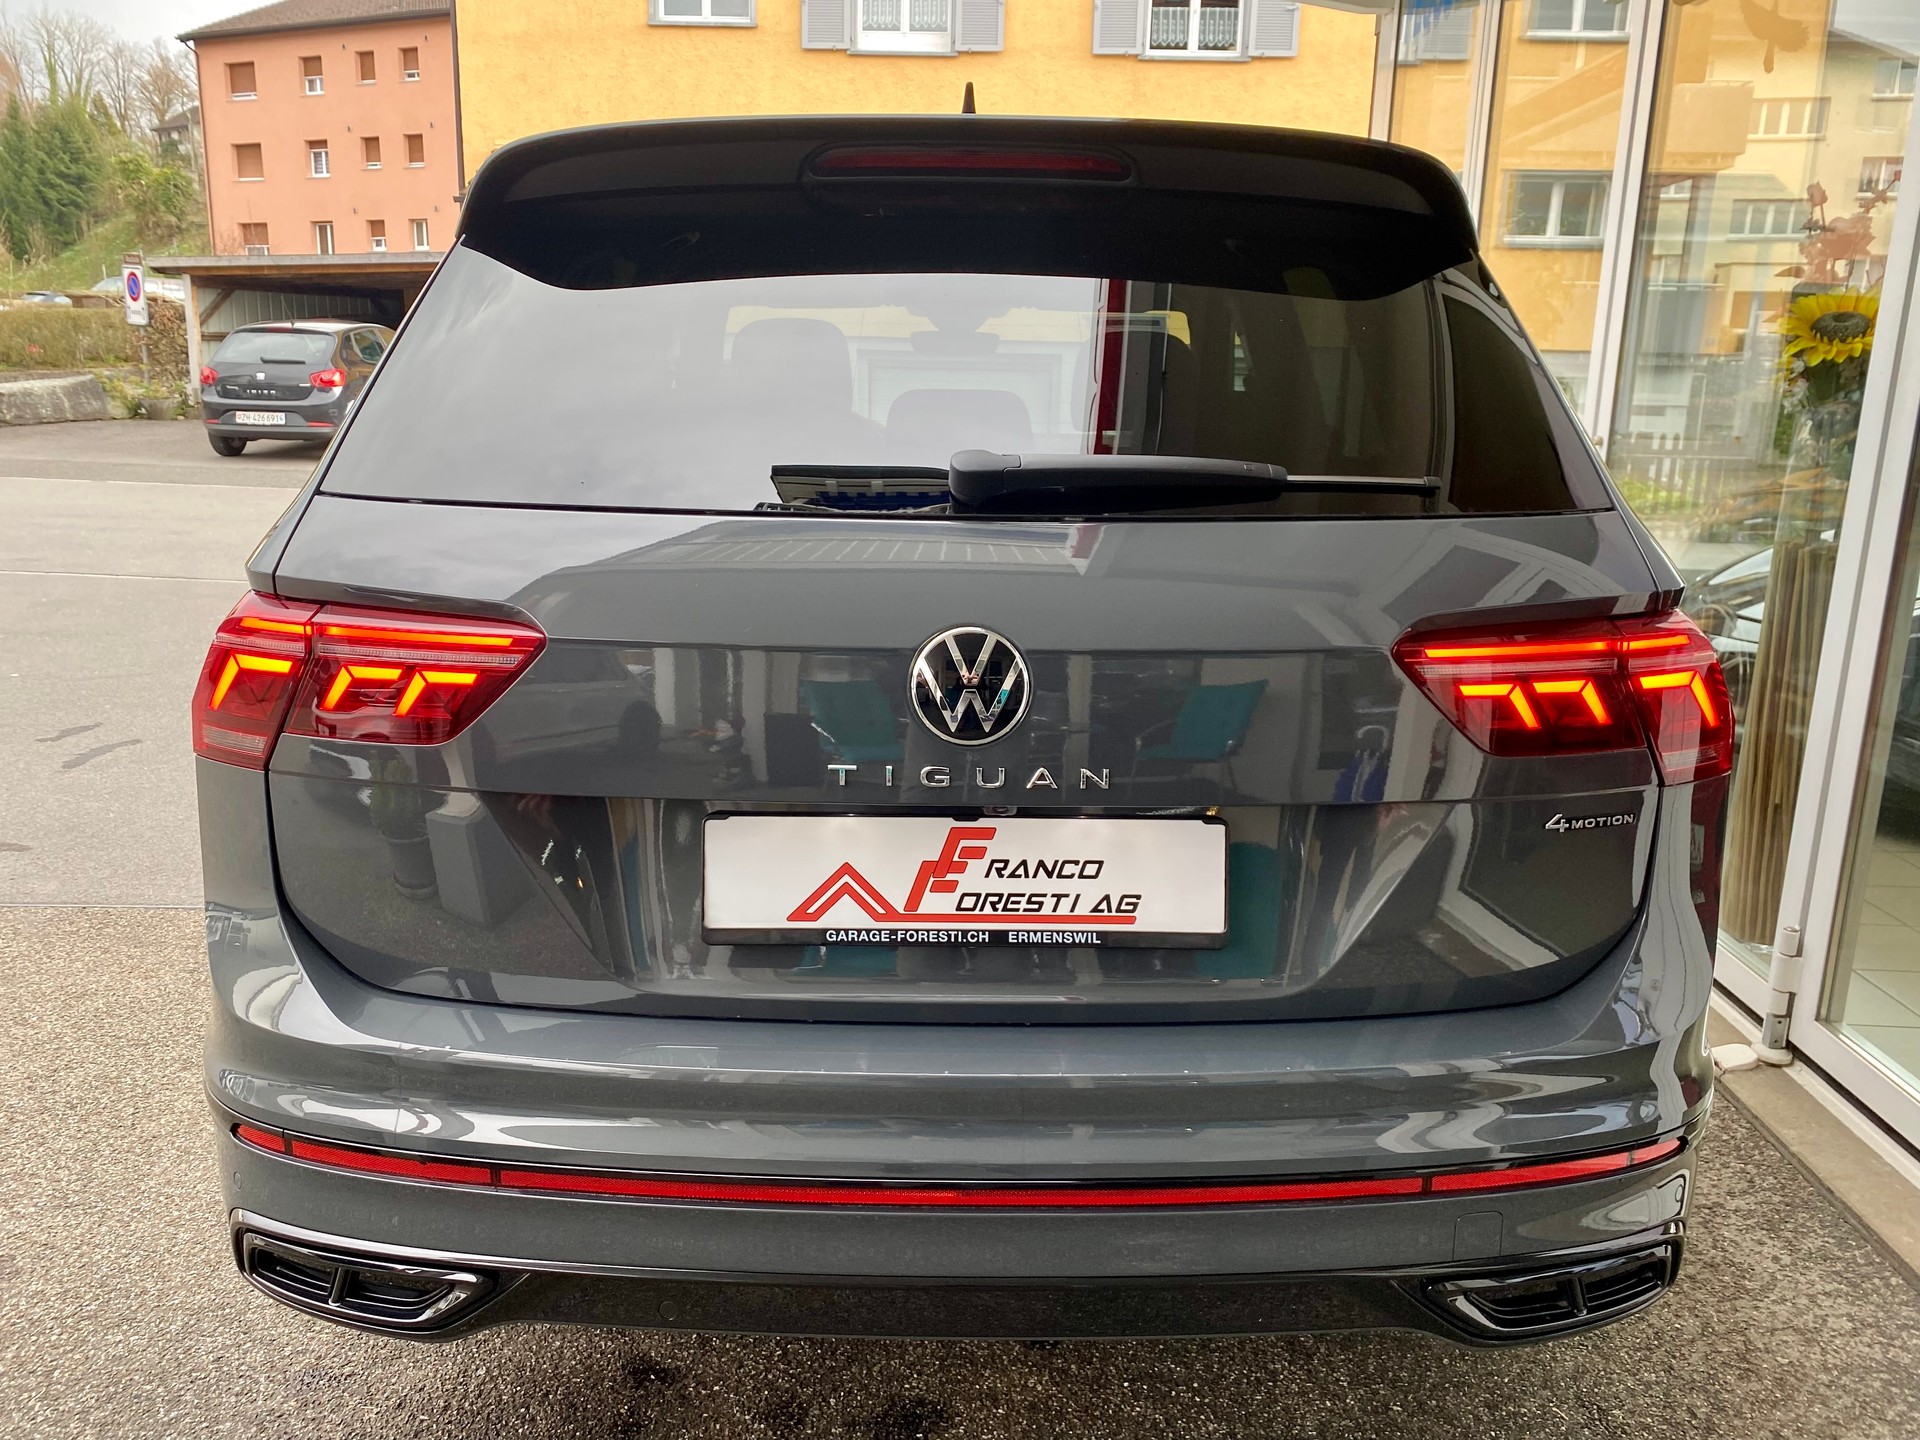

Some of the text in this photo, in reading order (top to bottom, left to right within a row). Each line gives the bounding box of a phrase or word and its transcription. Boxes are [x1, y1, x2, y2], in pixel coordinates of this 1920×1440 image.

[828, 764, 1111, 790] TIGUAN
[1545, 813, 1634, 833] 4MOTION
[932, 827, 1105, 880] FRANCO
[903, 860, 1143, 914] FORESTI AG
[826, 930, 1102, 944] GARAGE-FORESTI.CH ERMENSWIL
